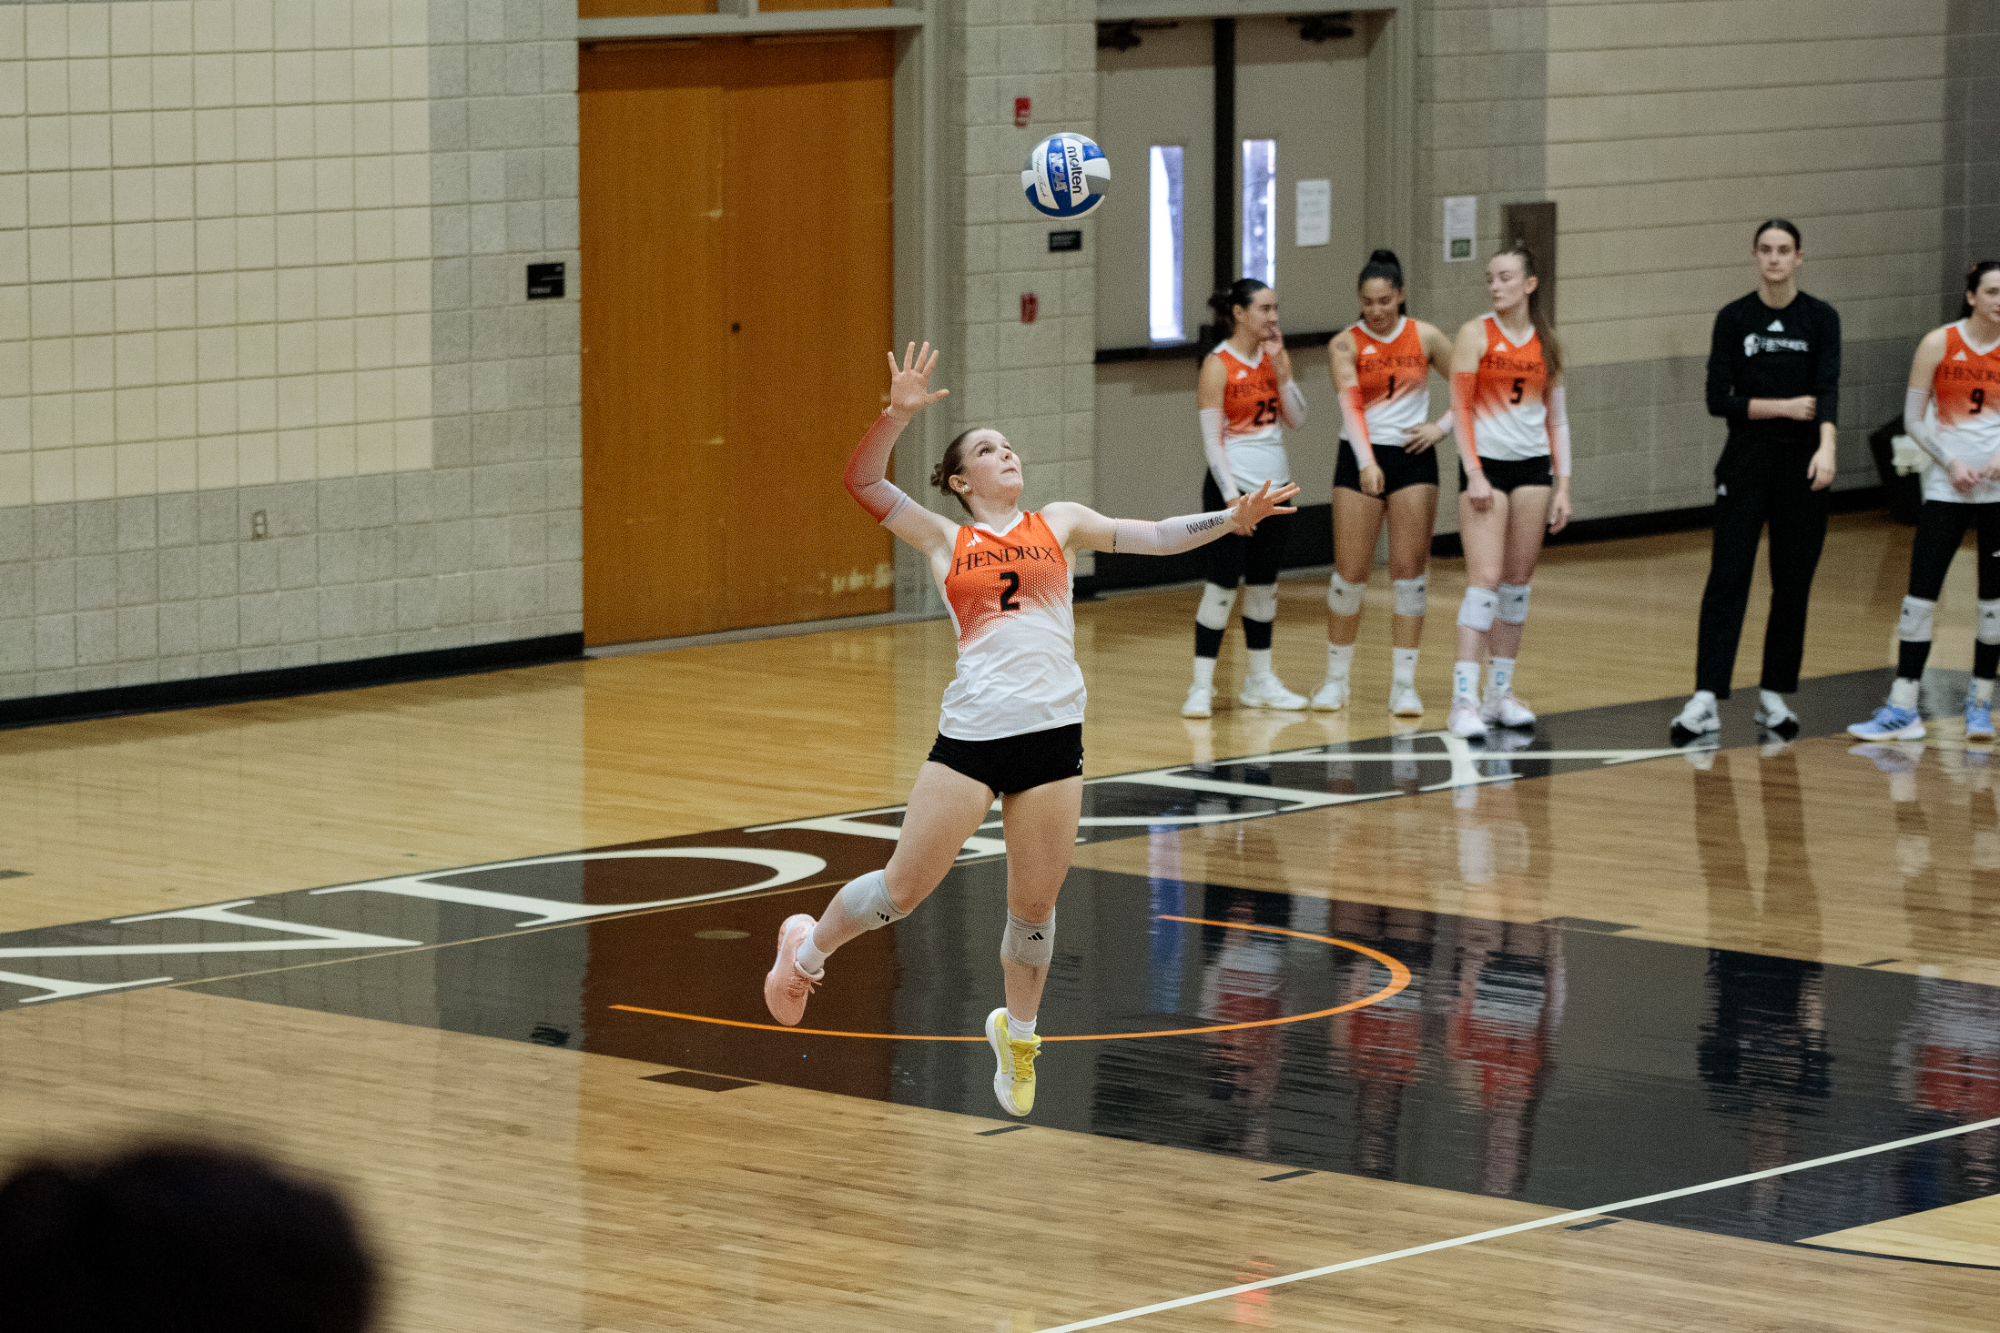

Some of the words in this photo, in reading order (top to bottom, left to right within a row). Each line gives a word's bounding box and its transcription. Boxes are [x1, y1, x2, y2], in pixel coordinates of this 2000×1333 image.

[1049, 152, 1068, 192] NCAA
[1066, 146, 1083, 194] molten
[1386, 375, 1395, 399] 1
[1511, 378, 1525, 404] 5
[1969, 388, 1985, 414] 9
[1253, 397, 1277, 427] 25
[955, 546, 1057, 575] HENDRIX
[1000, 571, 1019, 611] 2
